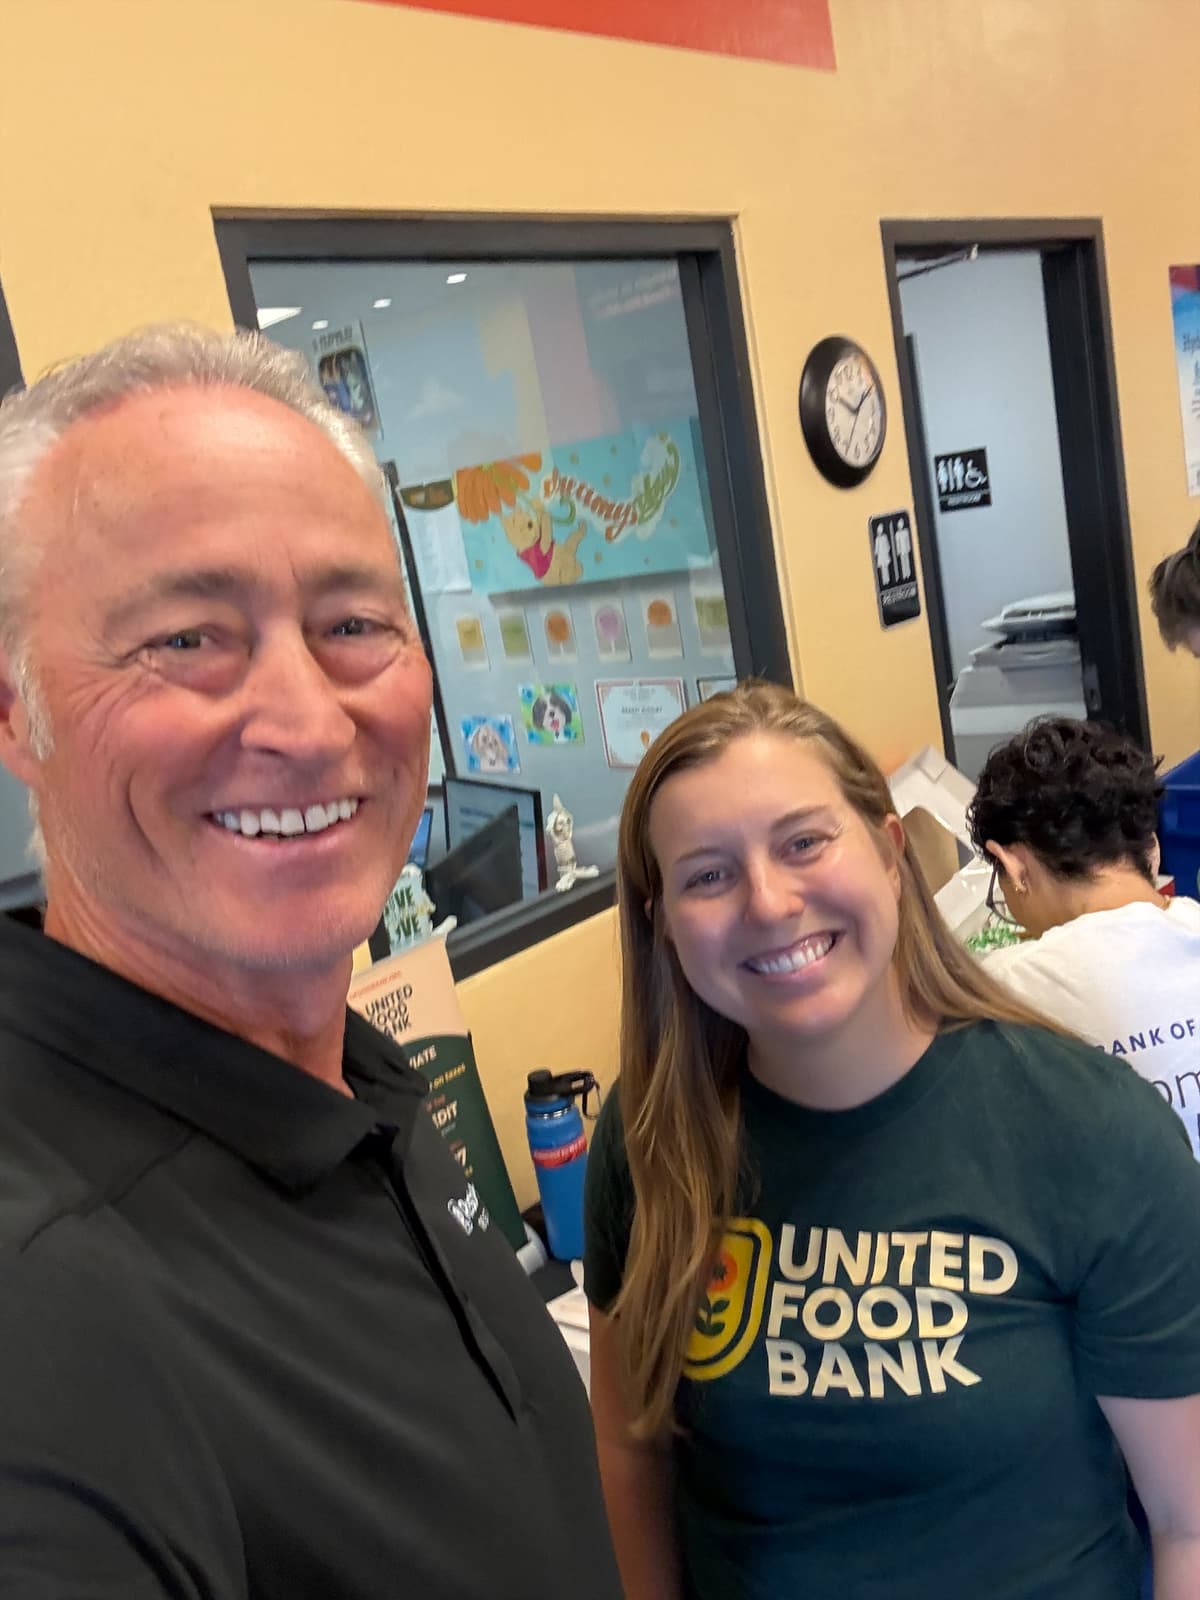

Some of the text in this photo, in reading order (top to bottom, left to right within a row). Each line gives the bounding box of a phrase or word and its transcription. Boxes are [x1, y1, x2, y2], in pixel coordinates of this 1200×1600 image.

[364, 983, 413, 1018] UNITED
[383, 1013, 412, 1039] ANK
[1096, 1018, 1196, 1057] ANK OF
[778, 1223, 1019, 1296] UNITED
[766, 1281, 969, 1341] FOOD
[765, 1335, 982, 1398] BANK
